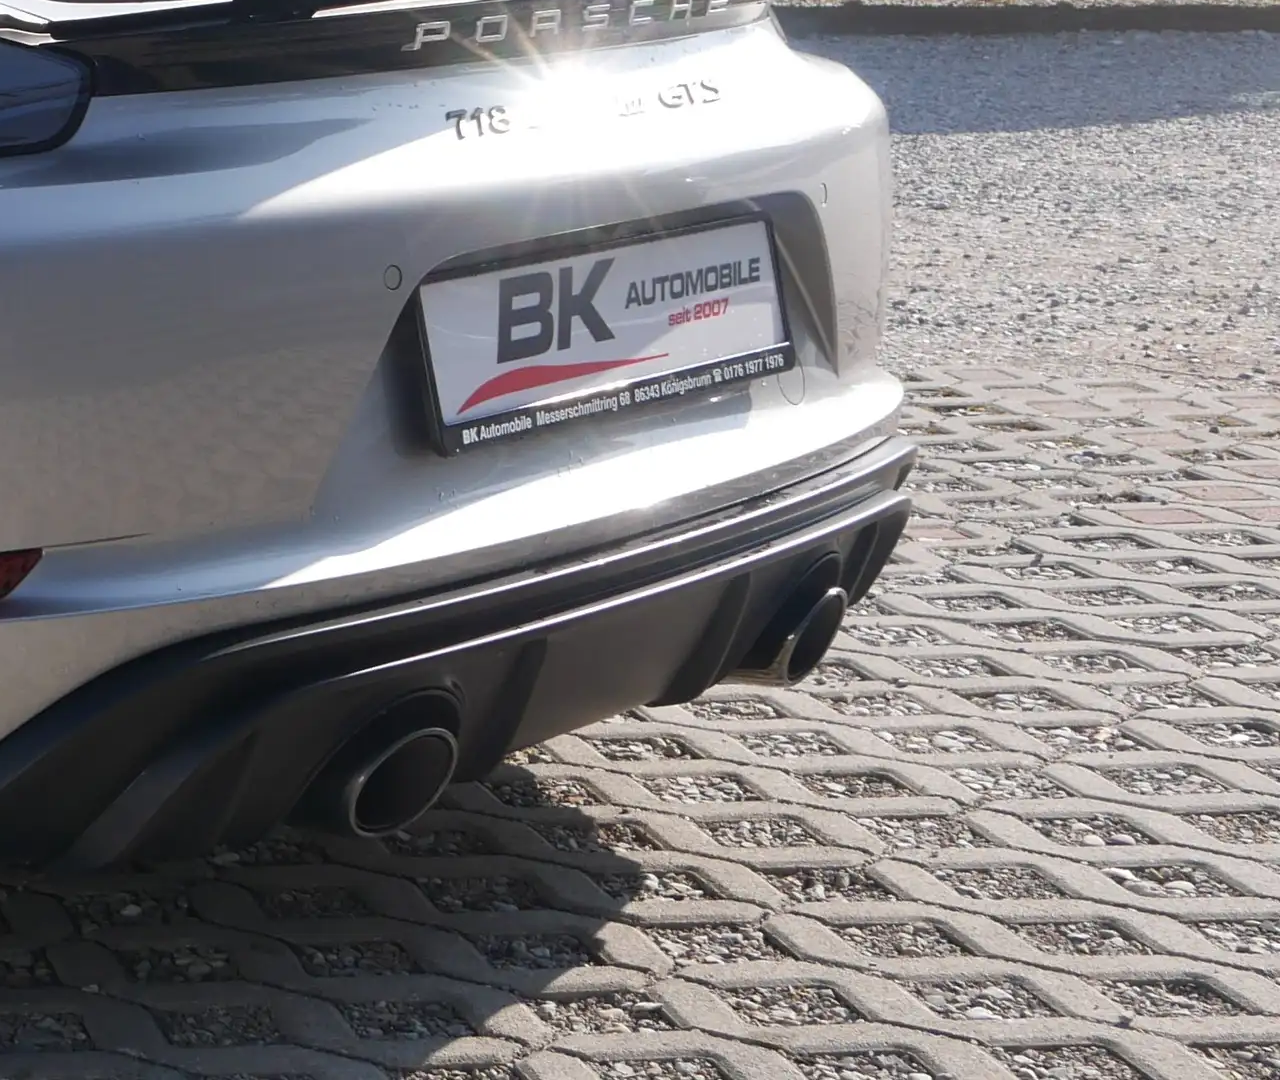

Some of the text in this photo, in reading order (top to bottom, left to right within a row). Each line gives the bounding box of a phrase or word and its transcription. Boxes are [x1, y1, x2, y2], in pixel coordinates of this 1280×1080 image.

[445, 105, 510, 140] 718
[658, 79, 721, 108] GTS
[497, 257, 761, 364] BK AUTOMOBILE
[668, 298, 729, 326] seit 2007
[462, 354, 785, 445] BK Automobile Messerschmittring 68 86343 Königsbrunn 0176 1977 1976
